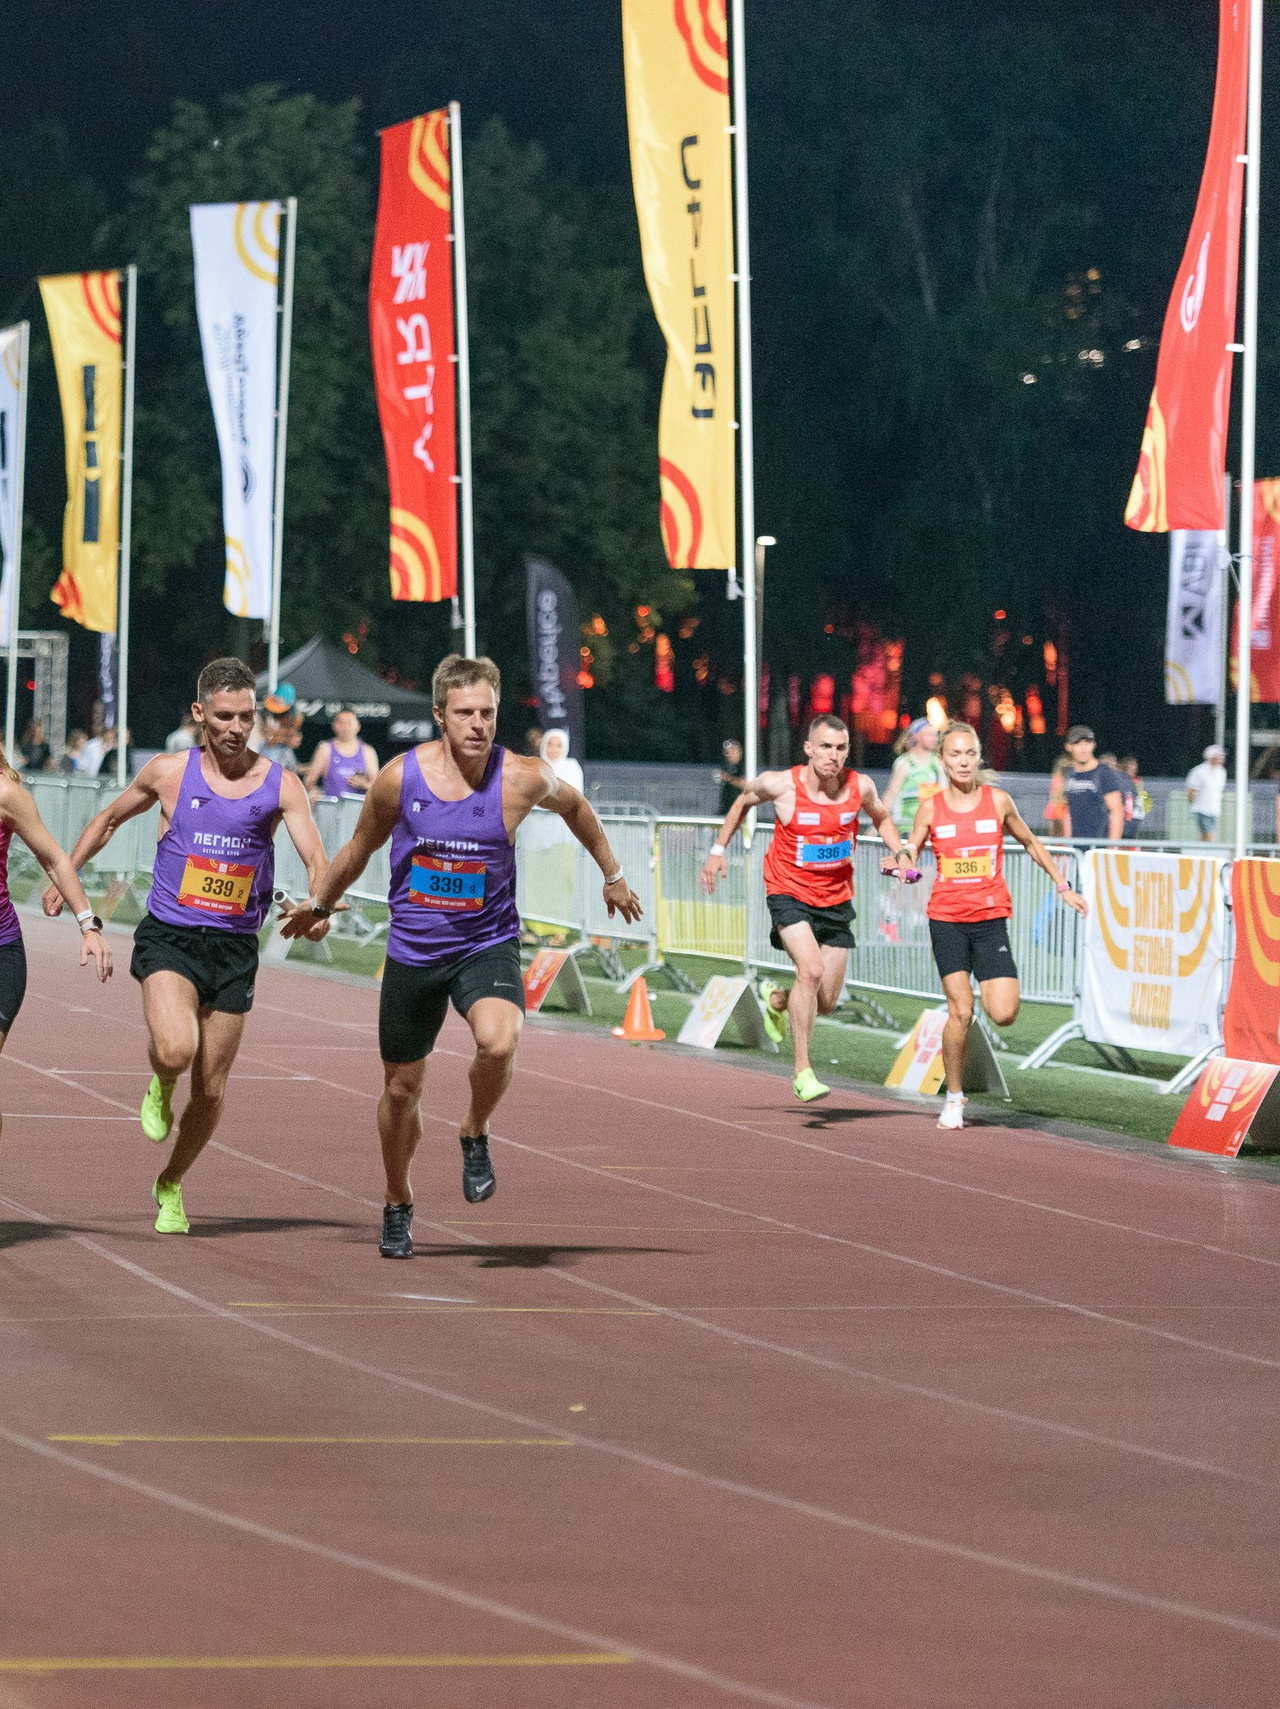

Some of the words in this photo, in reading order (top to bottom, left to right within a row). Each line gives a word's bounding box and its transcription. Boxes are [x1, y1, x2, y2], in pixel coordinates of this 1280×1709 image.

[193, 832, 251, 849] ЛЕГИОН
[415, 836, 479, 851] ЛЕГИОН
[817, 847, 840, 860] 336
[954, 861, 978, 874] 336
[202, 876, 234, 897] 339
[237, 890, 243, 898] 2
[429, 875, 463, 893] 339
[469, 885, 476, 894] 3
